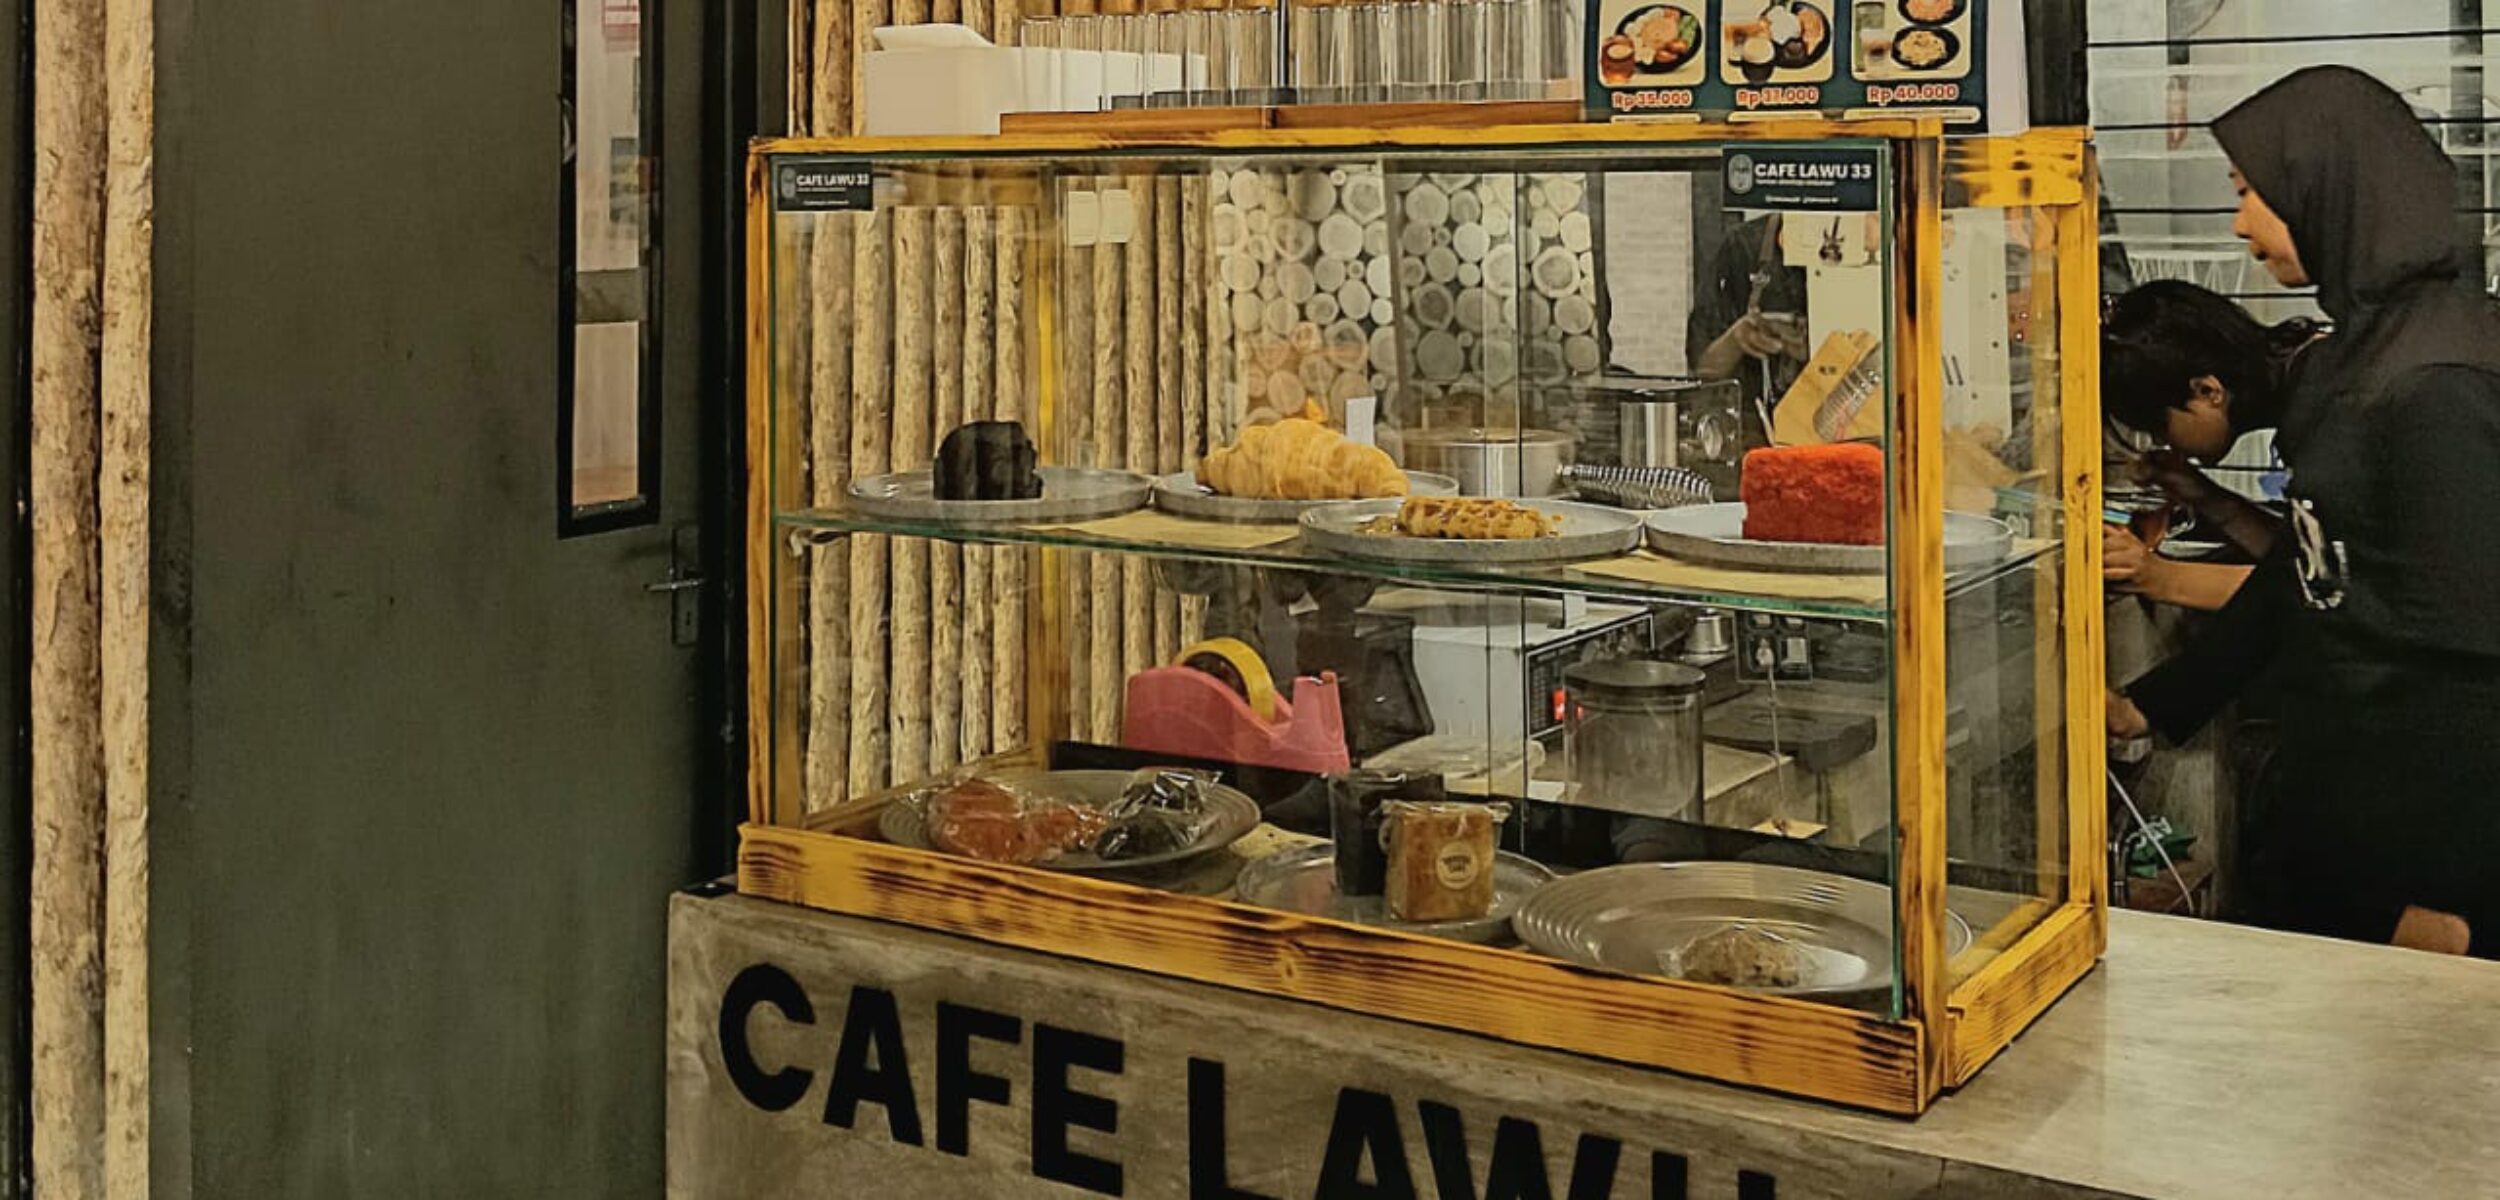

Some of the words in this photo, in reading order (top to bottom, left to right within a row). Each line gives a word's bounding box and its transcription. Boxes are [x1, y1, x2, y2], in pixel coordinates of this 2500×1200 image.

[1612, 92, 1634, 111] Rp
[1737, 90, 1760, 109] Rp
[1867, 84, 1893, 106] Rp
[1895, 82, 1959, 101] 40.000
[1754, 163, 1797, 178] CAFE
[1799, 163, 1848, 178] LAWU
[1851, 163, 1872, 179] 33
[719, 963, 1125, 1197] CAFE
